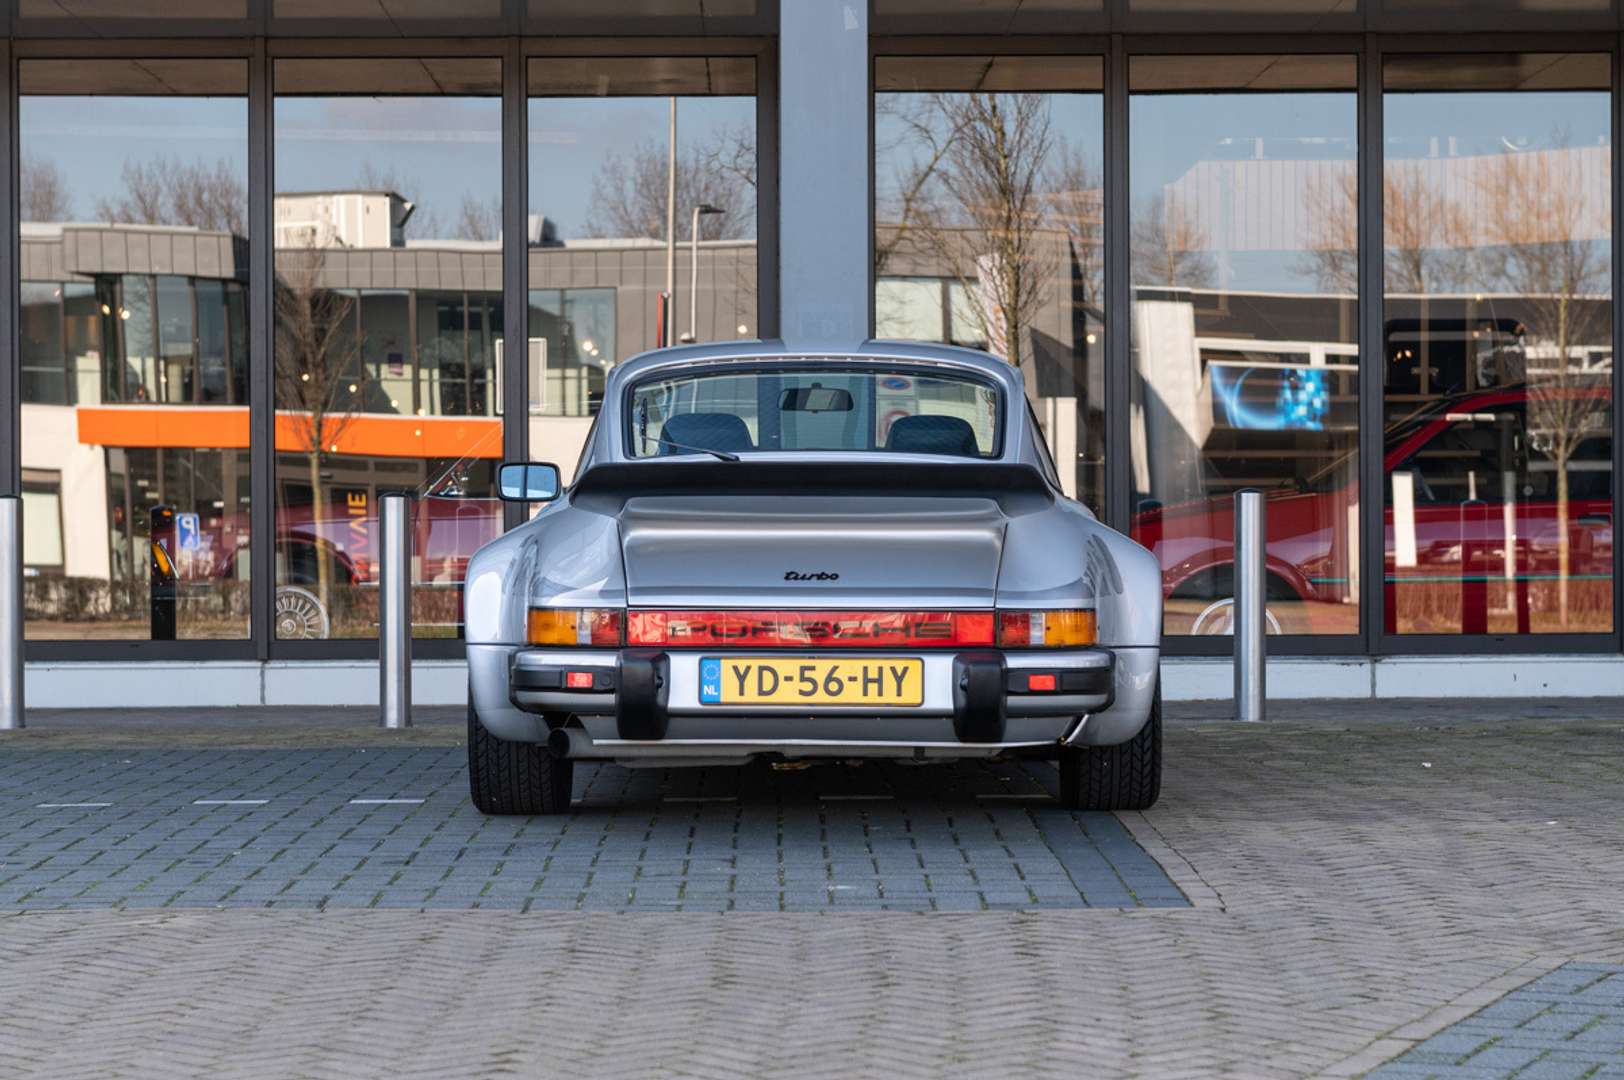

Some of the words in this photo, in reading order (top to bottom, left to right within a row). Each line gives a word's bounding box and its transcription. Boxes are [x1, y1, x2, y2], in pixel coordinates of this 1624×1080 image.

[784, 570, 840, 581] turbo
[731, 665, 909, 697] YD-56-HY
[703, 685, 719, 696] NL
